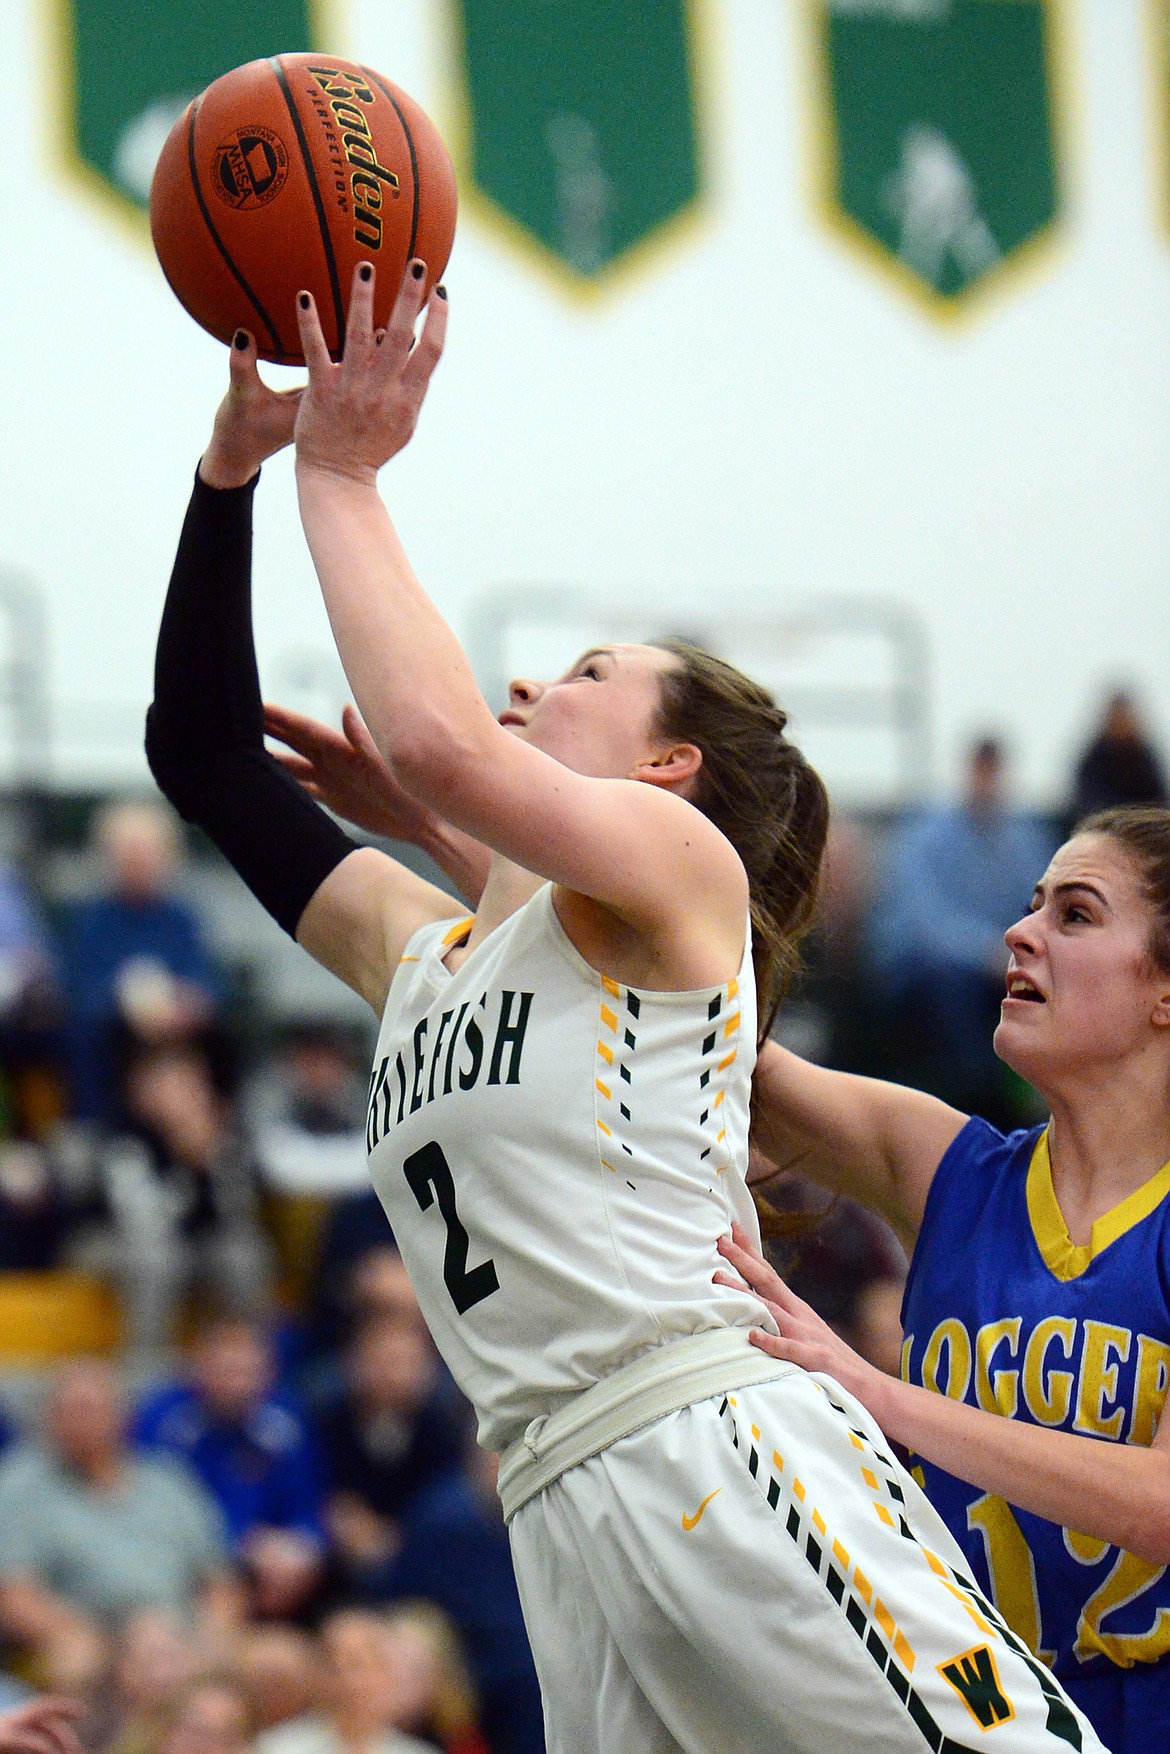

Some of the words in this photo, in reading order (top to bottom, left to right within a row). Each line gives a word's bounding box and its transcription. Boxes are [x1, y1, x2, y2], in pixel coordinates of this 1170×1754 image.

[217, 144, 253, 209] MHSA
[306, 88, 348, 214] PERFECTION
[306, 66, 399, 251] Baden
[402, 1140, 500, 1316] 2
[966, 1493, 1170, 1671] 12
[937, 1643, 1016, 1733] W
